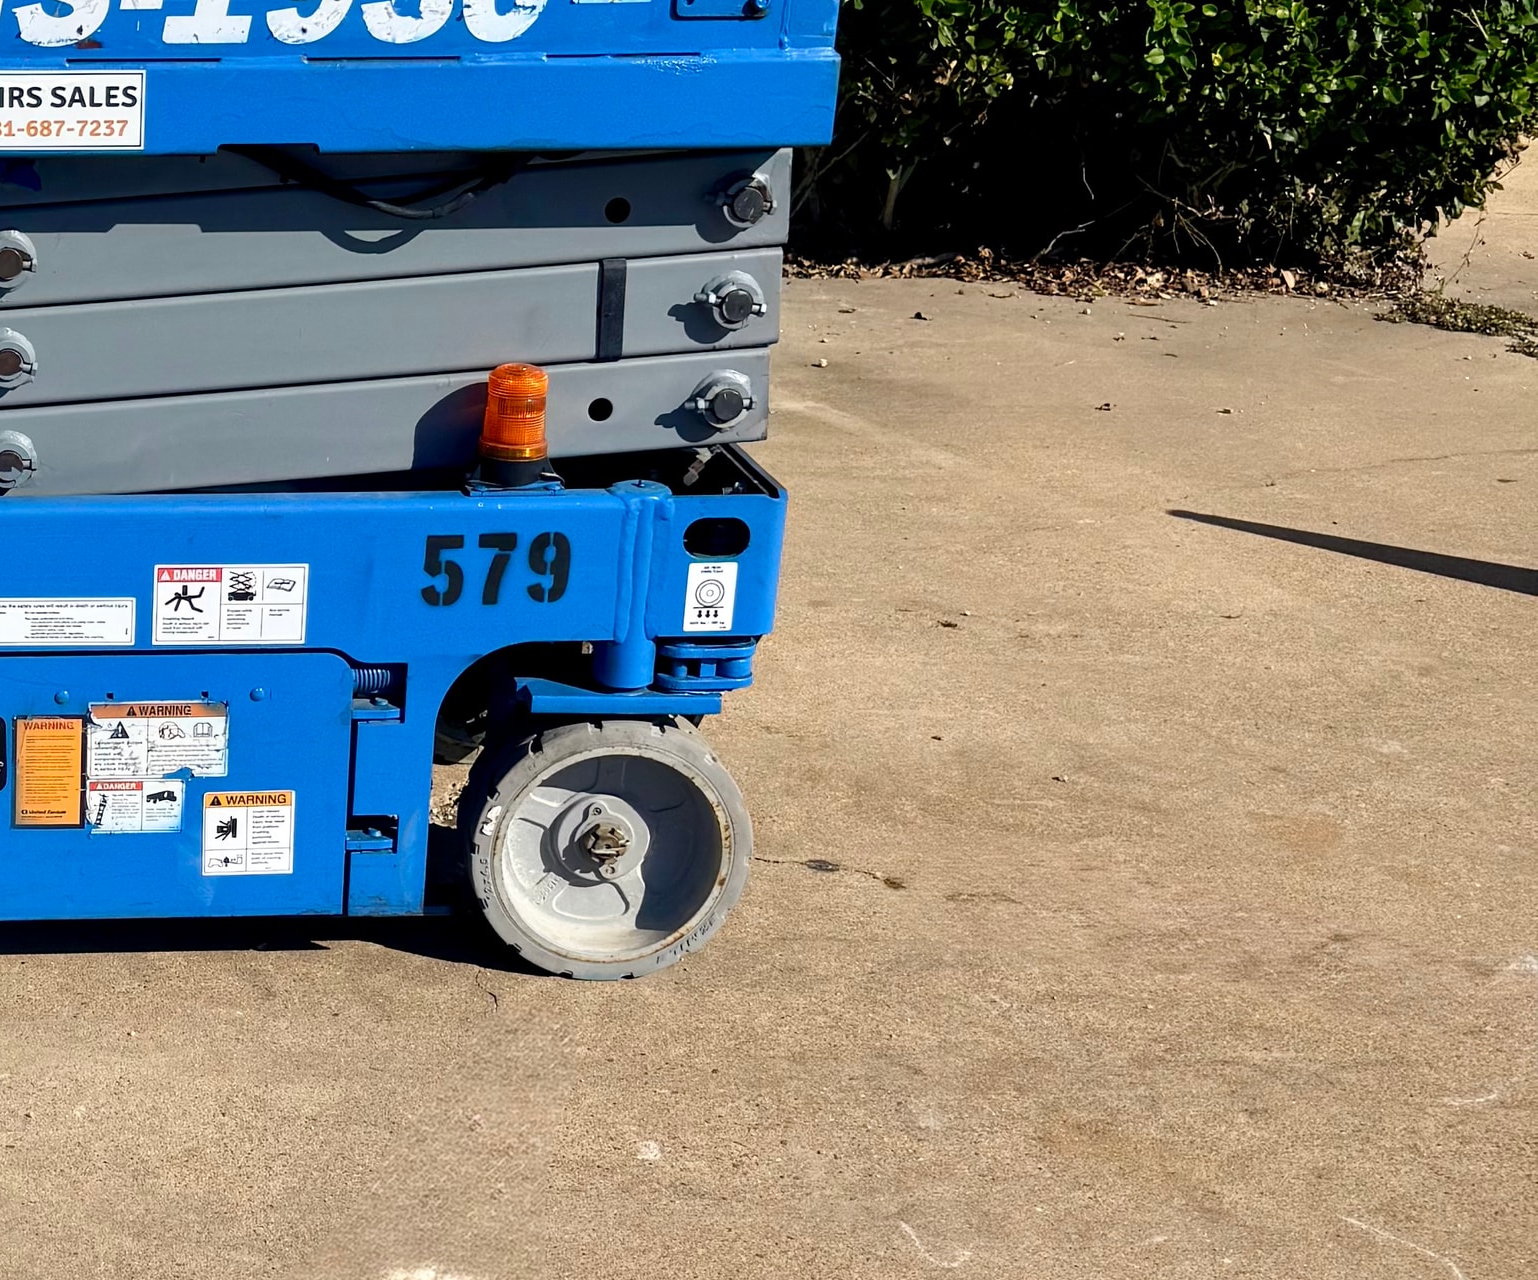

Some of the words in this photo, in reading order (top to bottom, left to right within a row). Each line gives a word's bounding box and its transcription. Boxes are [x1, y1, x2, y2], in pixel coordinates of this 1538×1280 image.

[50, 84, 139, 108] SALES
[173, 569, 217, 581] DANGER
[420, 531, 572, 607] 579
[138, 705, 192, 716] WARNING
[23, 721, 75, 730] WARNING
[103, 782, 137, 790] DANGER
[225, 793, 287, 805] WARNING
